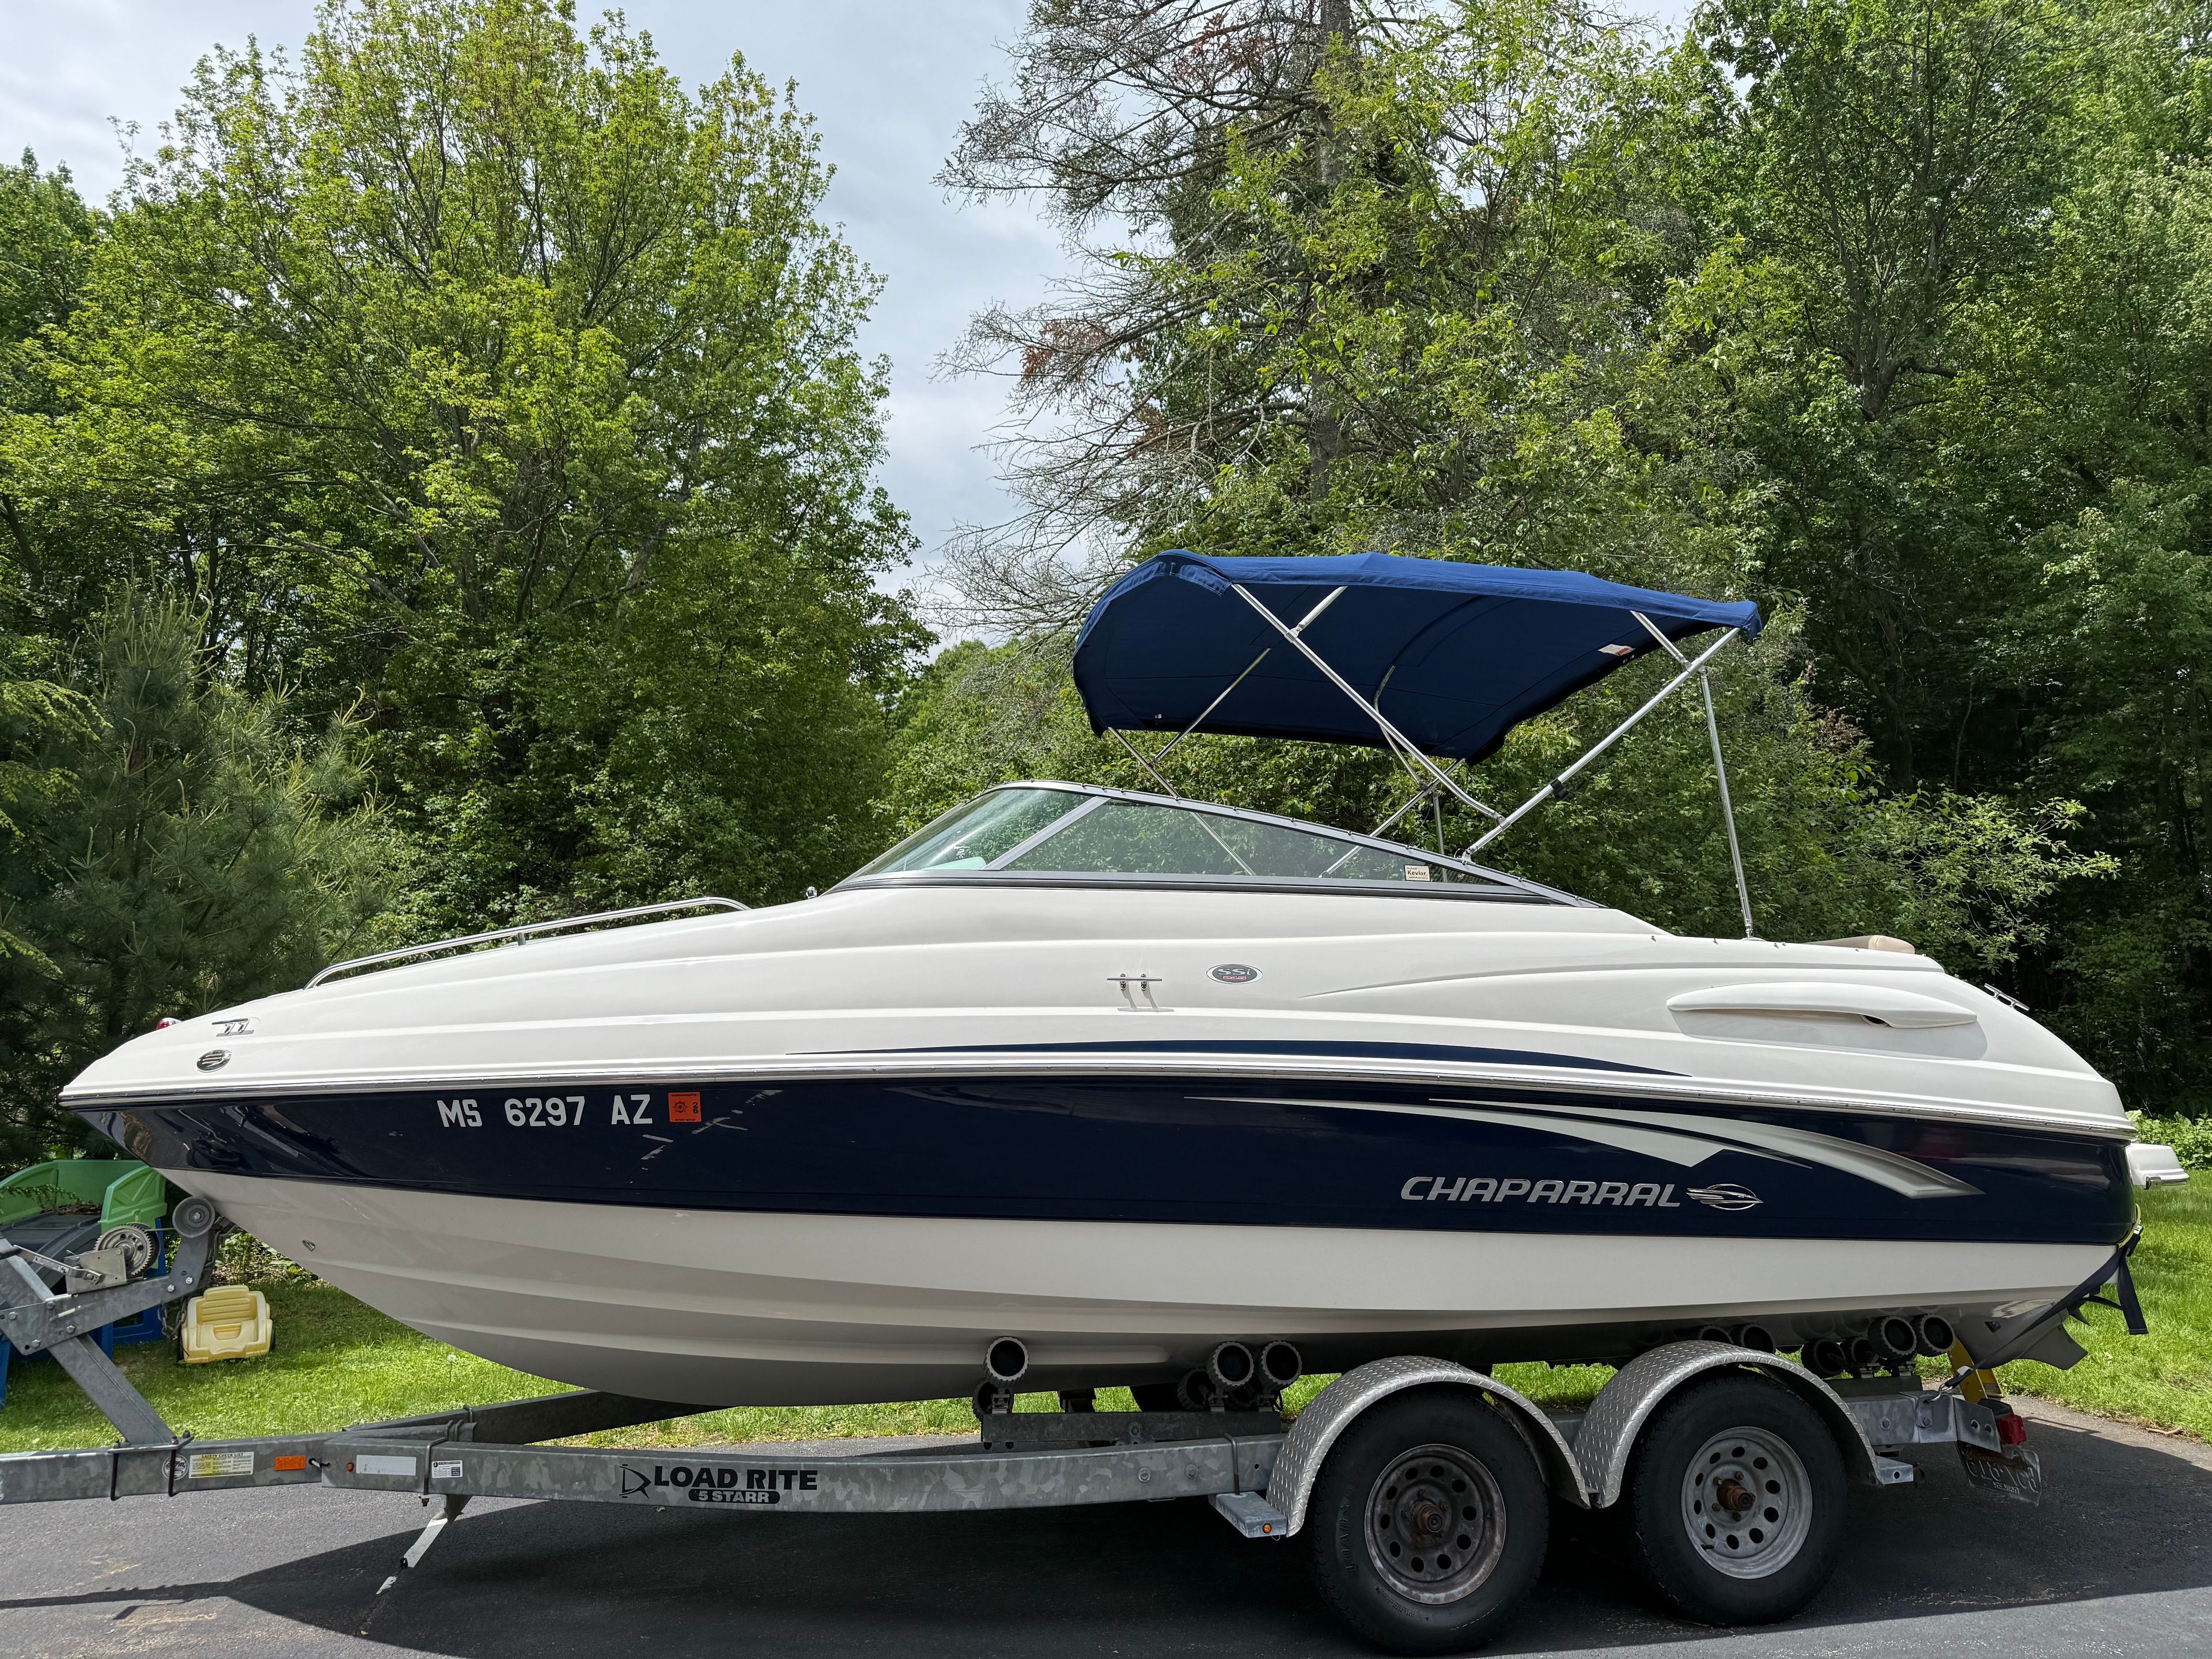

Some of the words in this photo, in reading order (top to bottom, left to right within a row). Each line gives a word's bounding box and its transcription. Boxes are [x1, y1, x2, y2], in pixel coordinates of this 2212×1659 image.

[437, 1099, 483, 1127] MS
[504, 1096, 586, 1127] 6297
[611, 1094, 653, 1125] AZ
[692, 1101, 699, 1114] 26
[1400, 1176, 1681, 1207] CHAPARRAL
[654, 1465, 738, 1489] LOAD
[746, 1469, 818, 1491] RITE
[698, 1490, 708, 1501] 5
[711, 1491, 770, 1503] STARR
